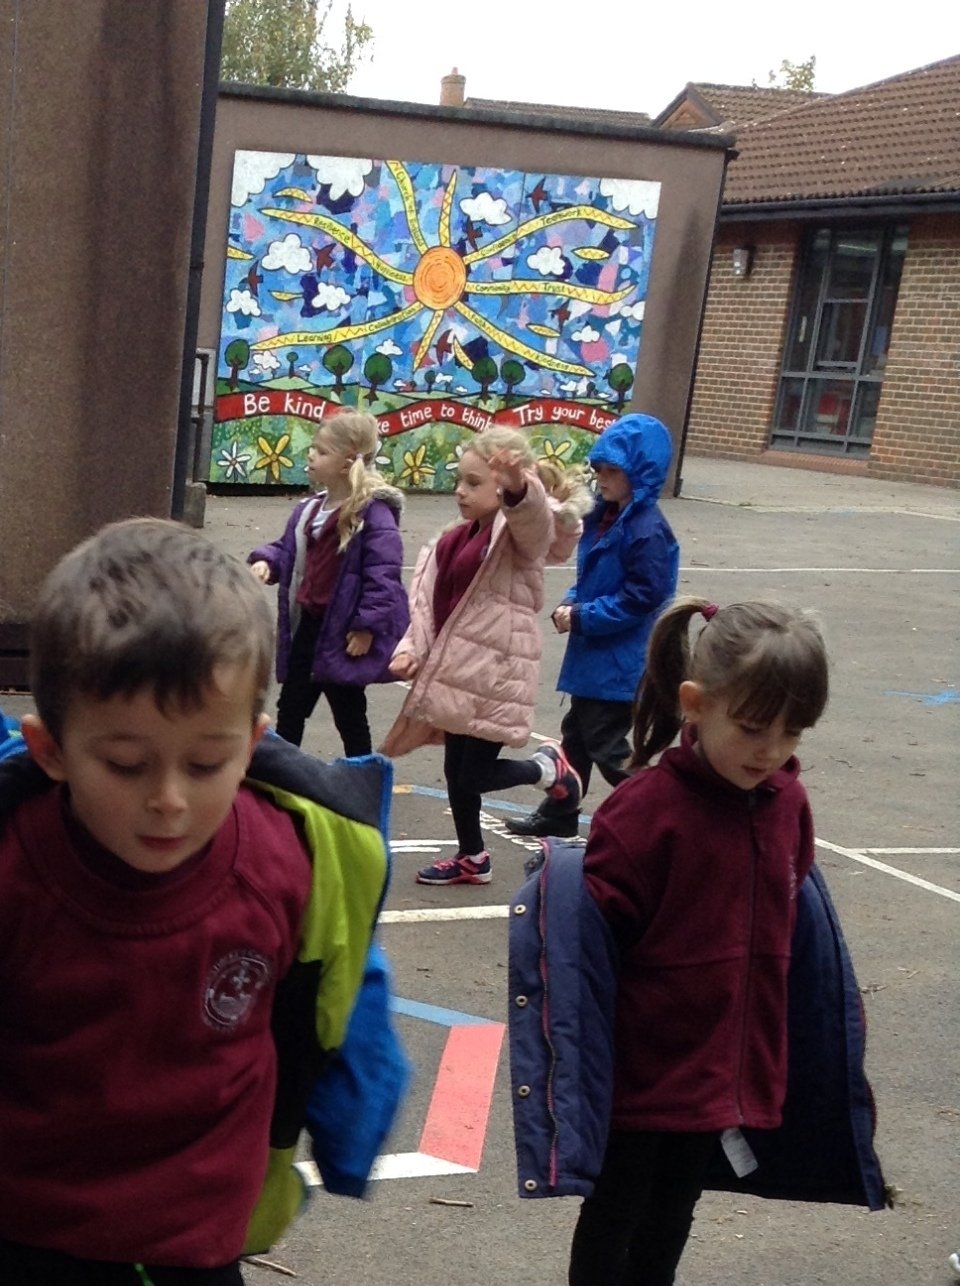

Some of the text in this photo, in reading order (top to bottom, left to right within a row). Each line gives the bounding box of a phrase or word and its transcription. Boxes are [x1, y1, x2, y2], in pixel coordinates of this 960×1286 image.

[244, 392, 327, 419] Be kind
[400, 406, 433, 427] time
[440, 403, 455, 418] to
[512, 404, 543, 425] Try
[551, 406, 585, 421] your
